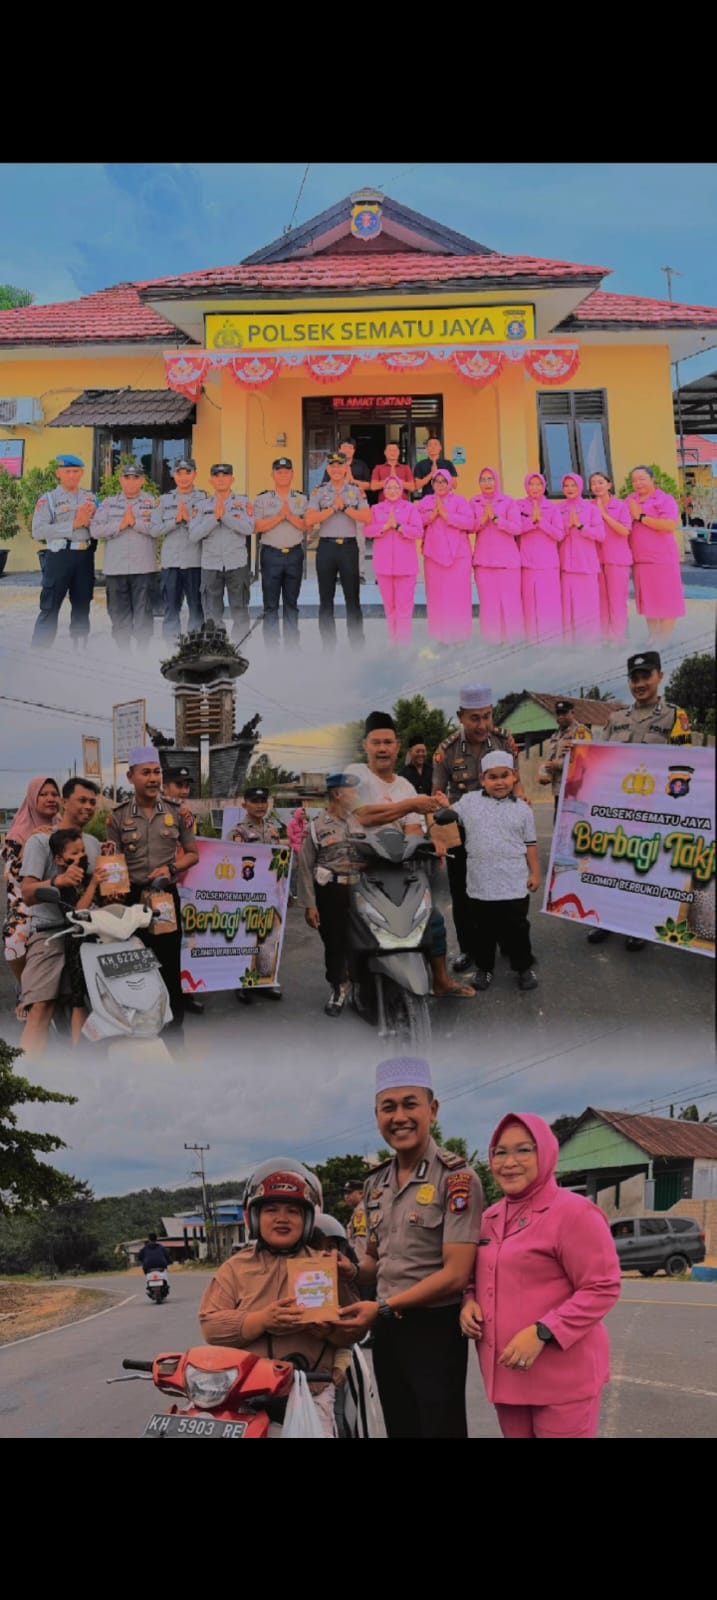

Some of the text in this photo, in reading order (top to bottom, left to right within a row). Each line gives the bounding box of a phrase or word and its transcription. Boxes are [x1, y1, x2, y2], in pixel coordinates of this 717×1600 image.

[247, 318, 495, 342] POLSEK SEMATU JAYA
[591, 805, 712, 830] POLSEK SEMATU JAYA
[574, 821, 661, 871] Berbagi
[581, 872, 695, 904] SELAMAT BERBUKA PUASA
[182, 904, 240, 939] Berbagi
[243, 905, 276, 940] Takjil
[100, 956, 115, 967] KH
[149, 1416, 243, 1438] KH 5903 RE
